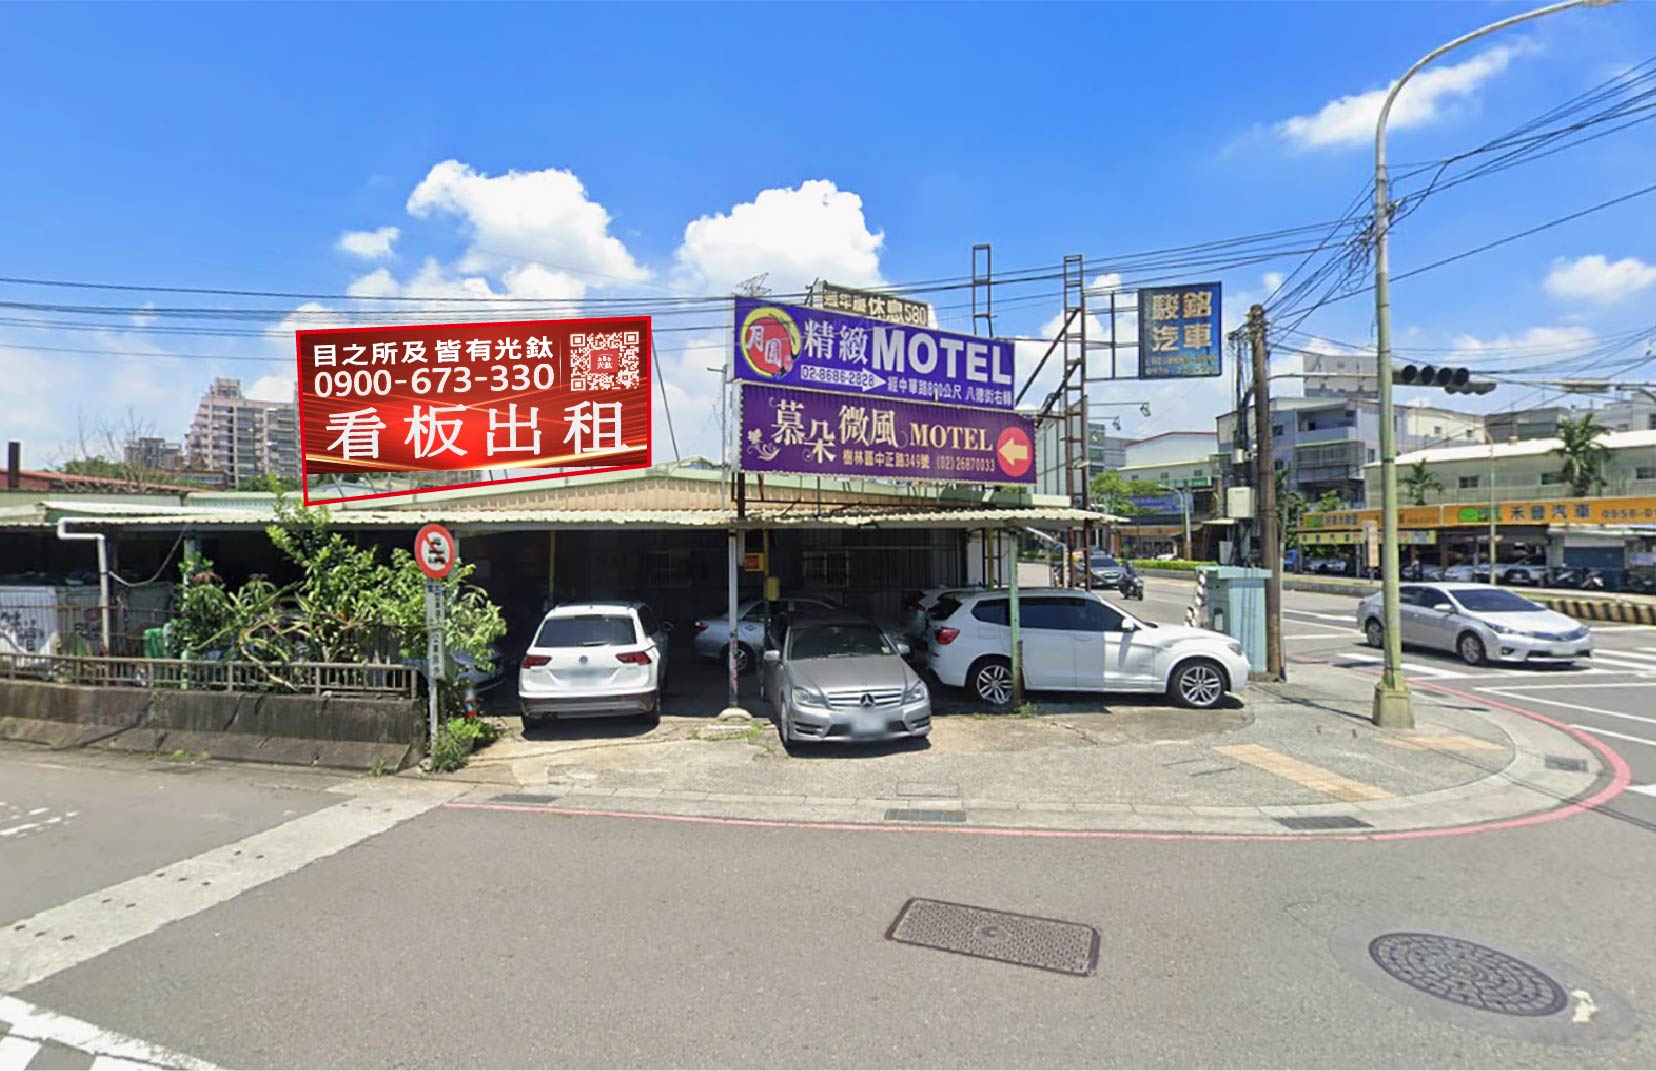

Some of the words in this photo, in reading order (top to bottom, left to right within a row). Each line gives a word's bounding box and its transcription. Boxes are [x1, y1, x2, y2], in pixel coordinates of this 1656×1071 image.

[313, 340, 428, 367] 目之所及
[434, 335, 554, 363] 皆有光鈦
[803, 319, 868, 365] 精緻
[872, 326, 1012, 385] MOTEL
[1152, 323, 1212, 352] 汽車
[314, 363, 555, 398] 0900-673-330
[325, 400, 630, 460] 看板出租
[908, 423, 994, 451] MOTEL
